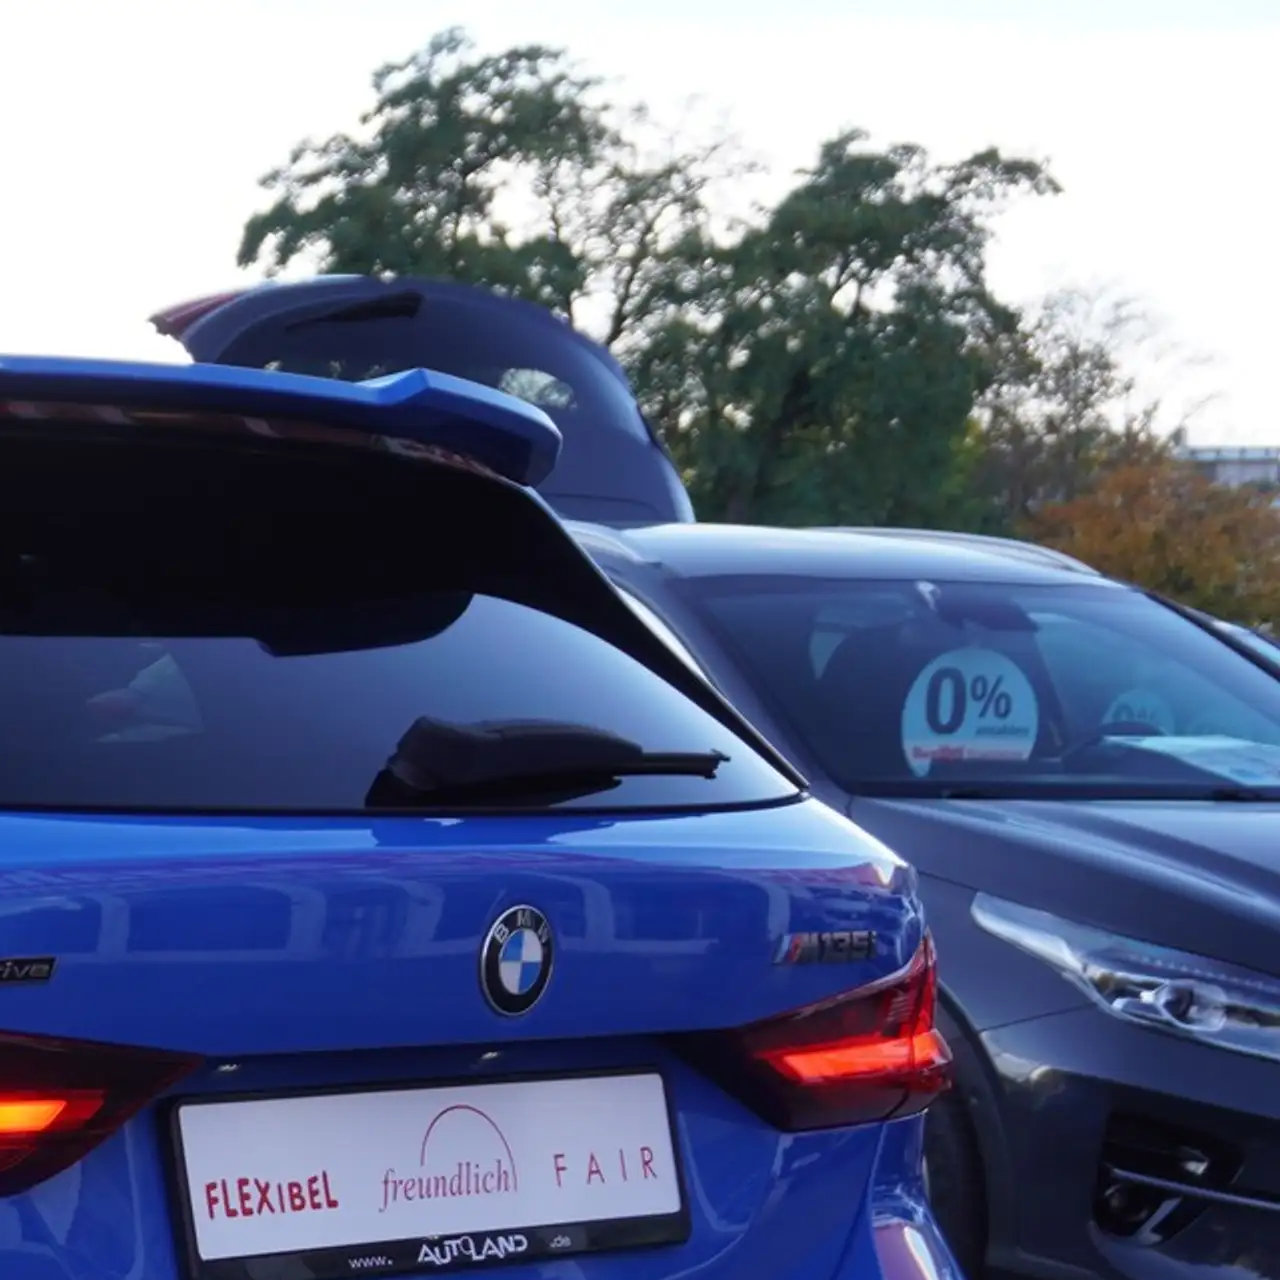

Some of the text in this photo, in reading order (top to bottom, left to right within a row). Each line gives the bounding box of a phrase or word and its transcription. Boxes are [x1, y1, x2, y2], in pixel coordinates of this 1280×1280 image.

[926, 666, 1012, 736] 0%
[494, 909, 550, 944] BMW
[205, 1146, 658, 1220] FLEXIBEL freundlich FAIR
[417, 1234, 529, 1265] AUTOLAND
